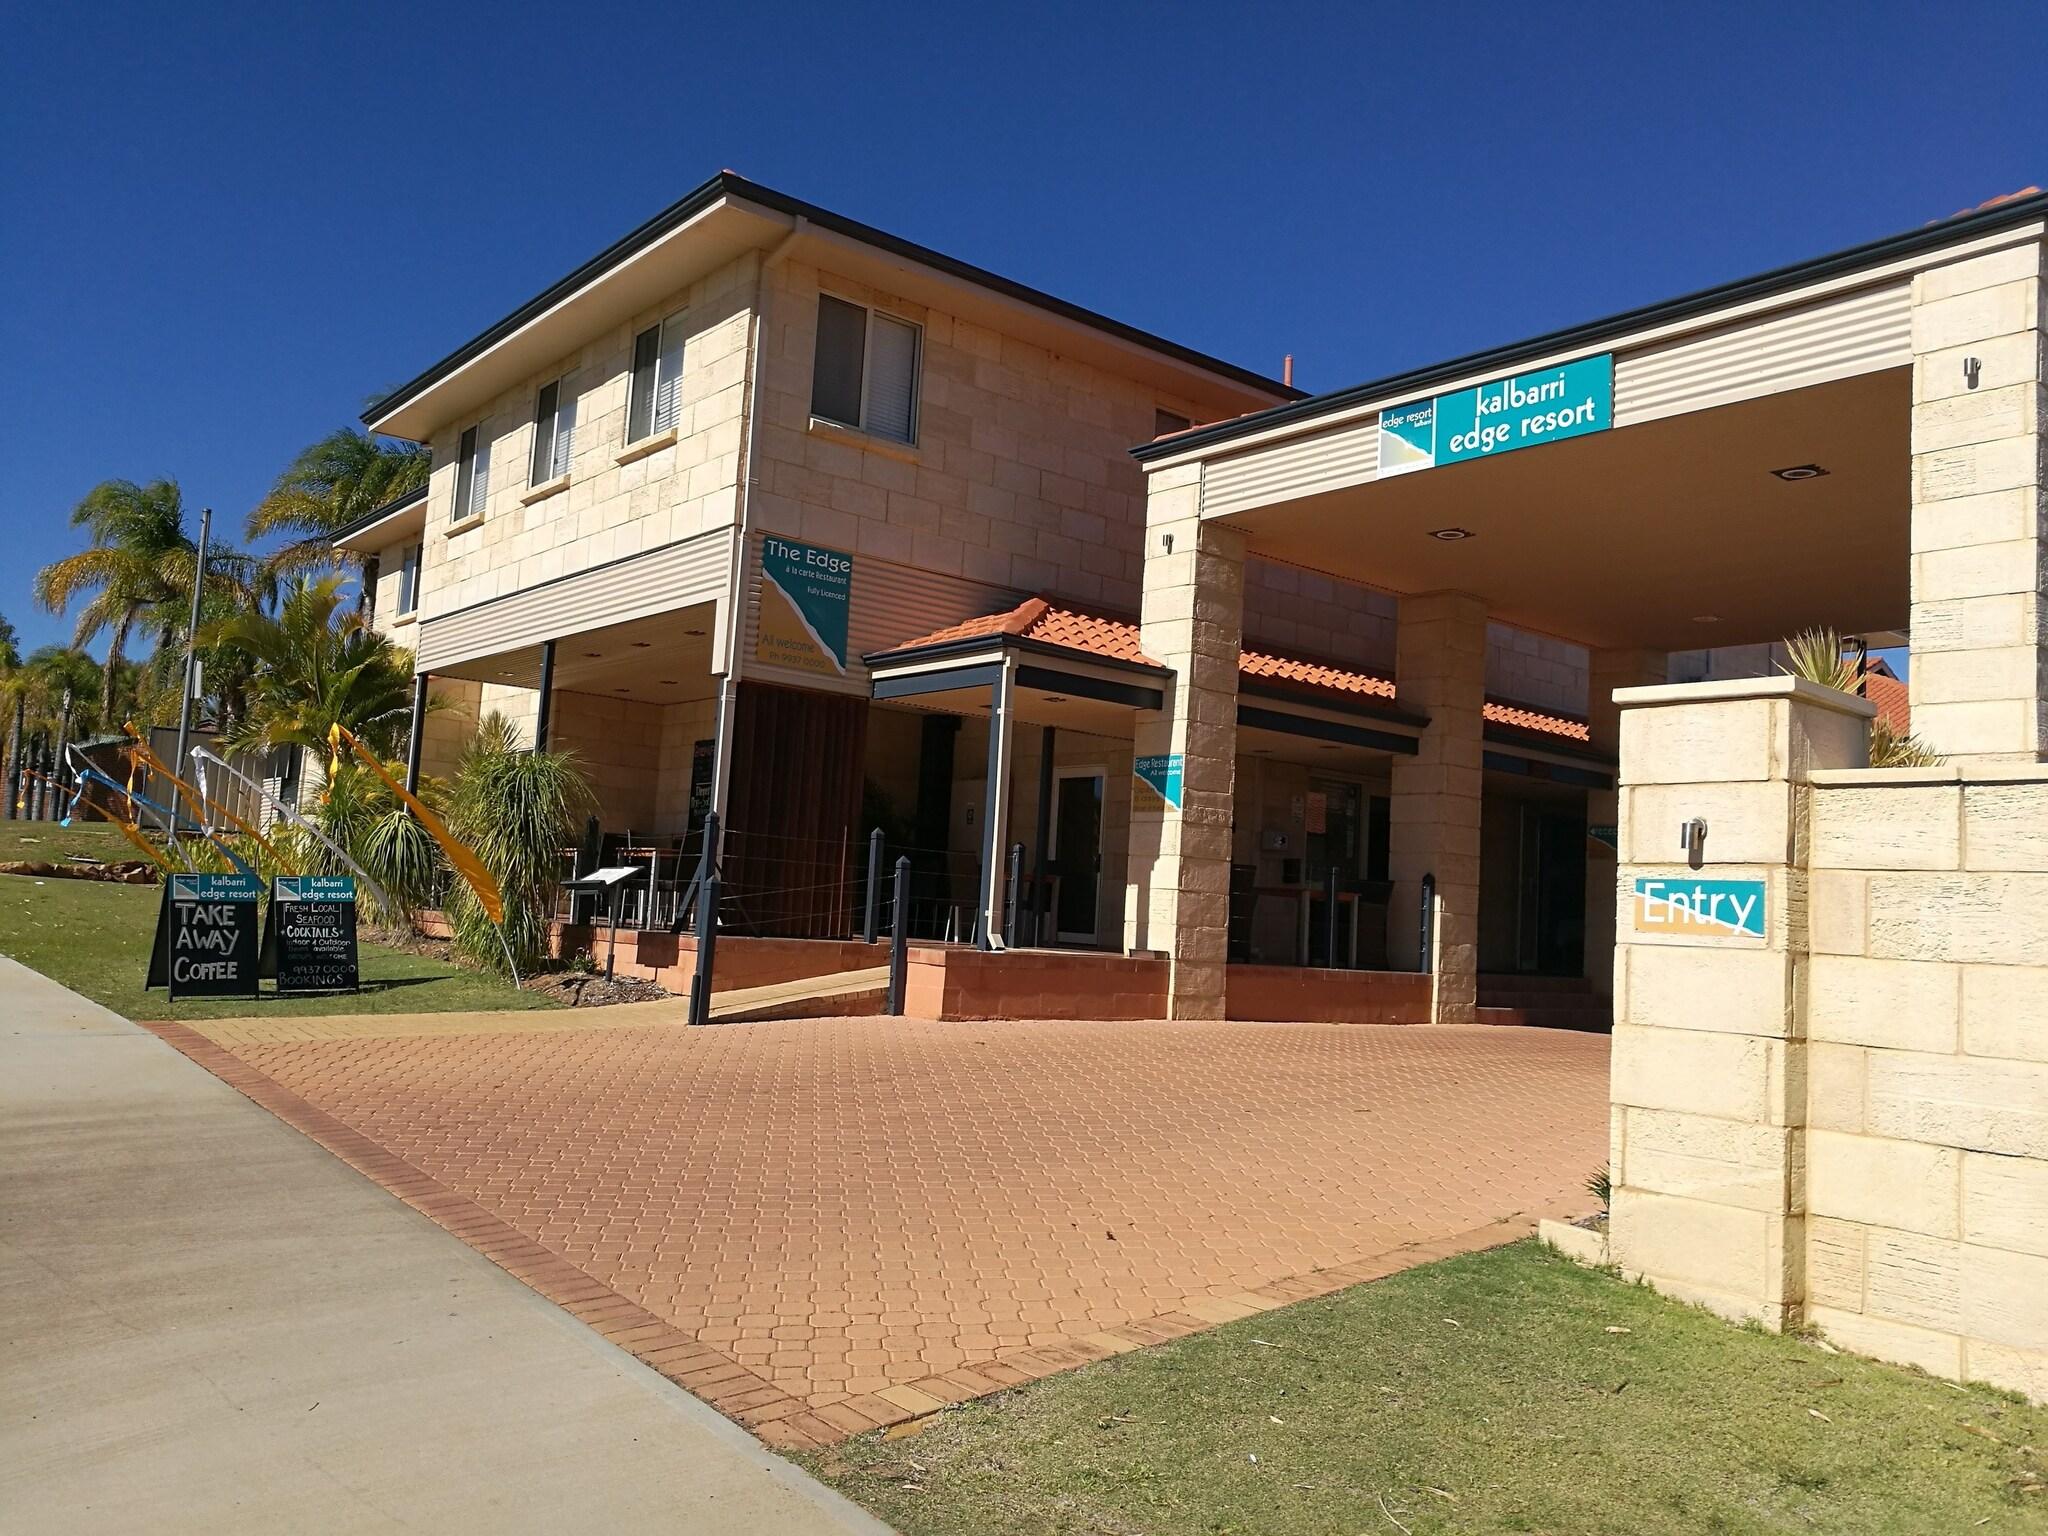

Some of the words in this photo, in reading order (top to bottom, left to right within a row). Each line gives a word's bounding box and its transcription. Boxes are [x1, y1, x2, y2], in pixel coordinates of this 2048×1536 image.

[1476, 372, 1565, 417] kalbarri
[1382, 413, 1404, 428] edge
[1406, 407, 1432, 422] resort
[1449, 416, 1511, 453] edge
[1521, 396, 1595, 437] resort
[767, 540, 801, 561] The
[806, 549, 851, 573] Edge
[791, 566, 798, 575] la
[798, 569, 815, 578] carte
[816, 571, 847, 584] Restaurant
[807, 586, 820, 596] Fully
[1135, 759, 1150, 770] Edge
[1151, 758, 1183, 768] Restaurant
[211, 875, 246, 887] kalbarri
[311, 878, 344, 888] kalbarri
[200, 887, 226, 900] edge
[228, 890, 256, 899] resort
[301, 888, 325, 901] edge
[327, 890, 353, 899] resort
[174, 902, 236, 926] TAKE
[284, 902, 309, 913] FRESH
[311, 902, 340, 913] LOCAL
[1643, 882, 1757, 936] Entry
[295, 914, 336, 924] SEAFOOD
[286, 925, 340, 938] COCKTAILS
[175, 926, 240, 956] AWAY
[318, 938, 351, 946] Outdoor
[174, 956, 238, 983] COFFEE
[293, 965, 321, 974] 9937
[279, 972, 344, 986] BOOKINGS
